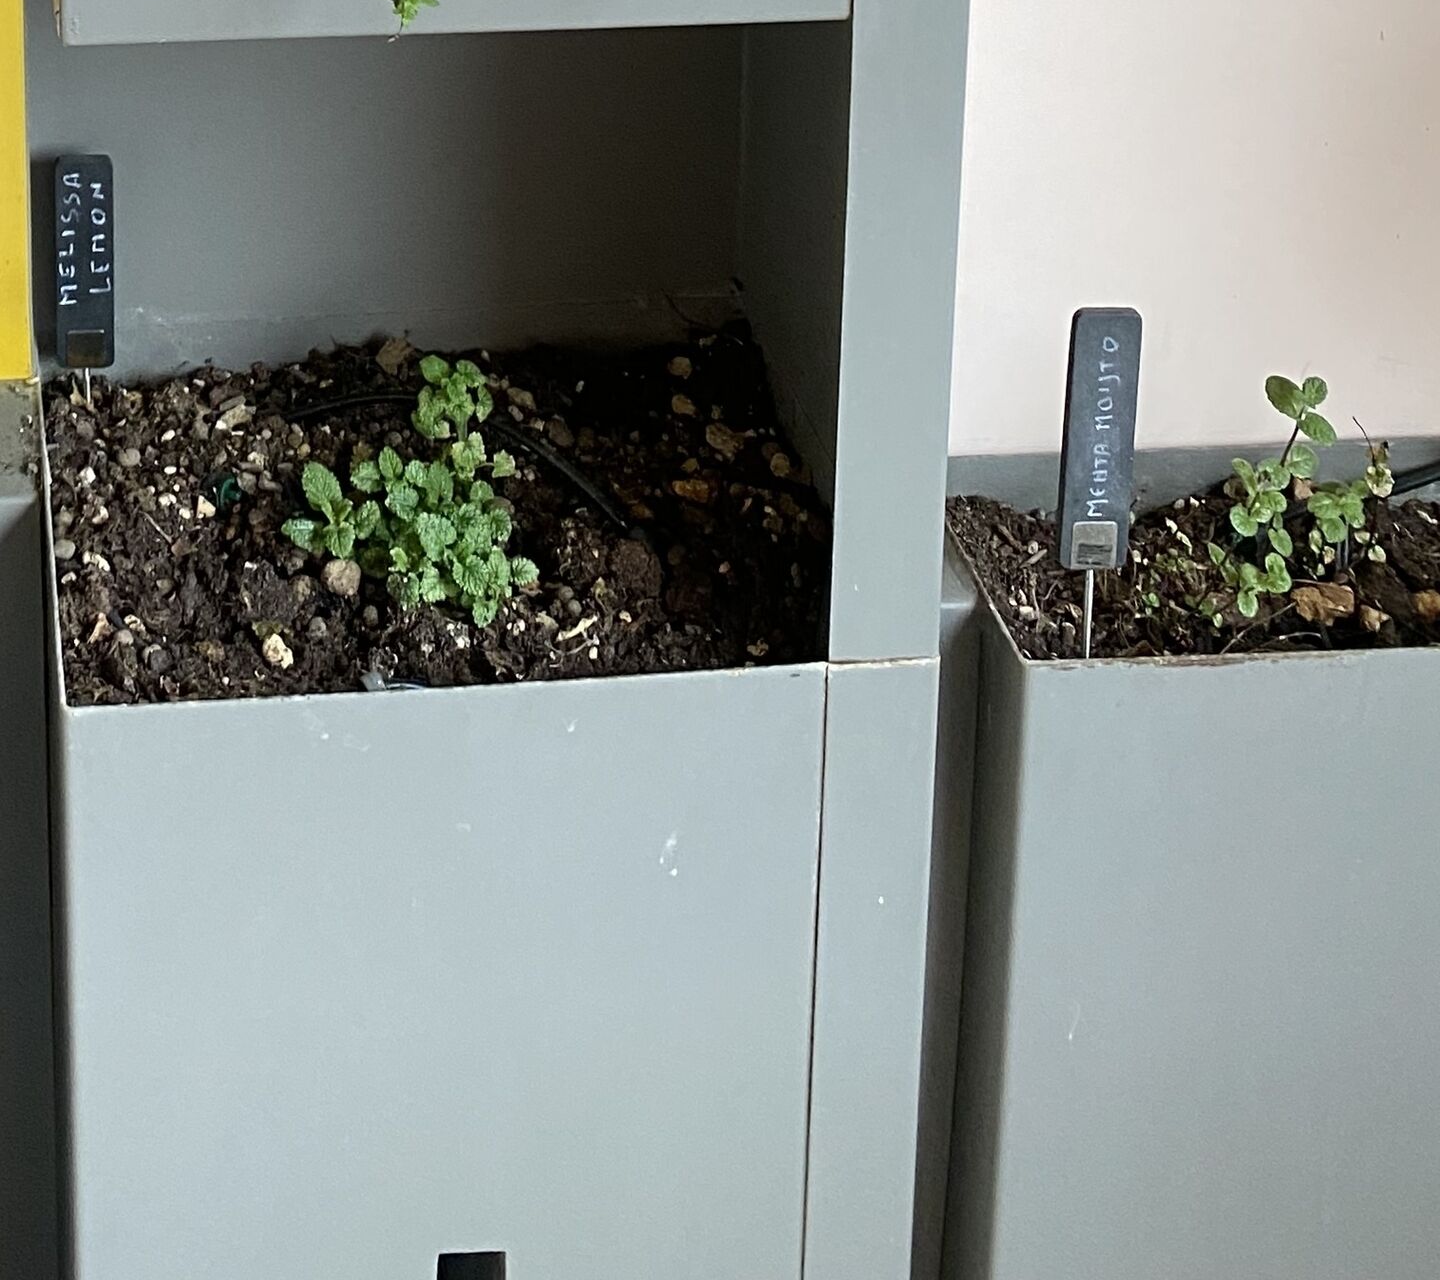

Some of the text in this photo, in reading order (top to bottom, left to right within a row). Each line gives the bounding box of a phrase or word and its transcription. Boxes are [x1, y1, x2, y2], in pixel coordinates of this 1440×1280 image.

[58, 171, 82, 306] MELISSA
[89, 182, 112, 294] LEMON
[1086, 443, 1109, 518] MENTA
